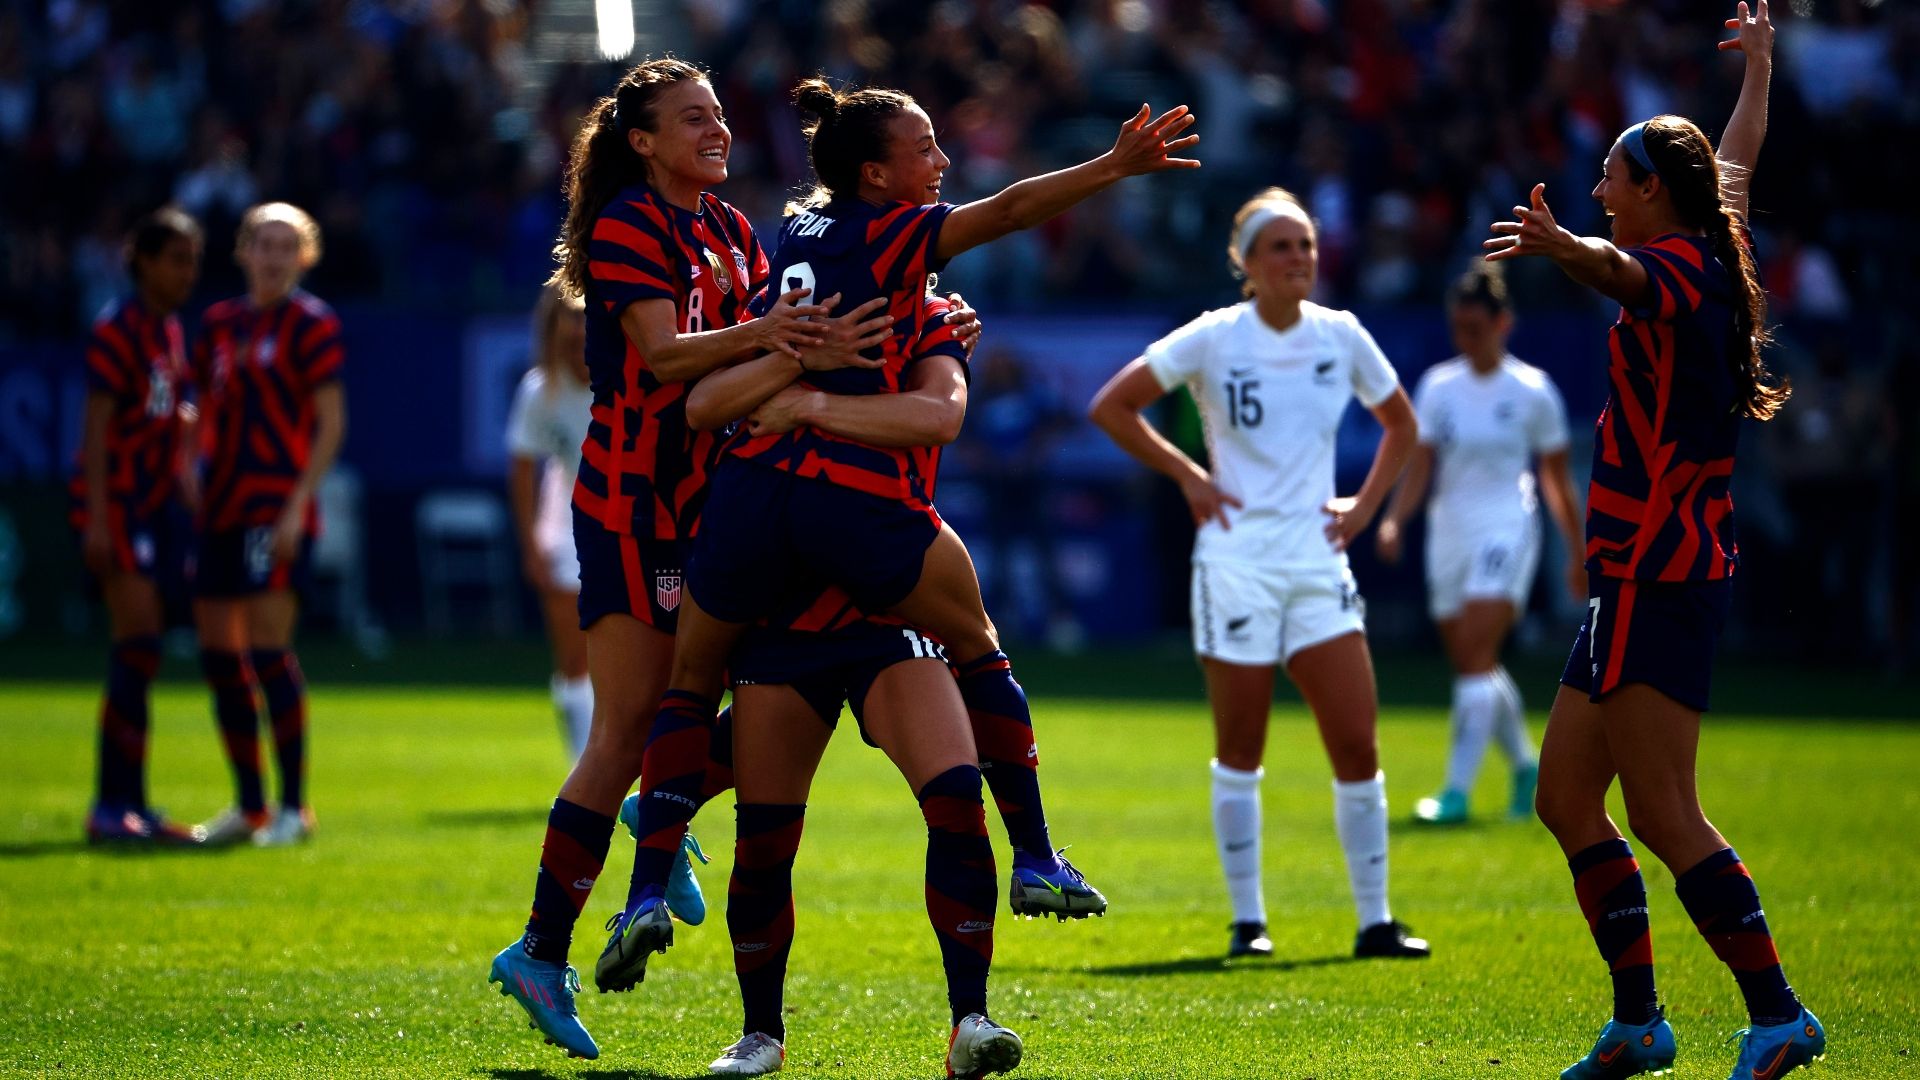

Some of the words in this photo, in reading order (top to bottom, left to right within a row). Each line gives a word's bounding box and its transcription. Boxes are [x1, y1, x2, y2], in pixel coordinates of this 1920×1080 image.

[687, 288, 704, 333] 8
[1225, 381, 1264, 429] 15
[658, 577, 680, 591] USA
[1589, 597, 1601, 658] 7
